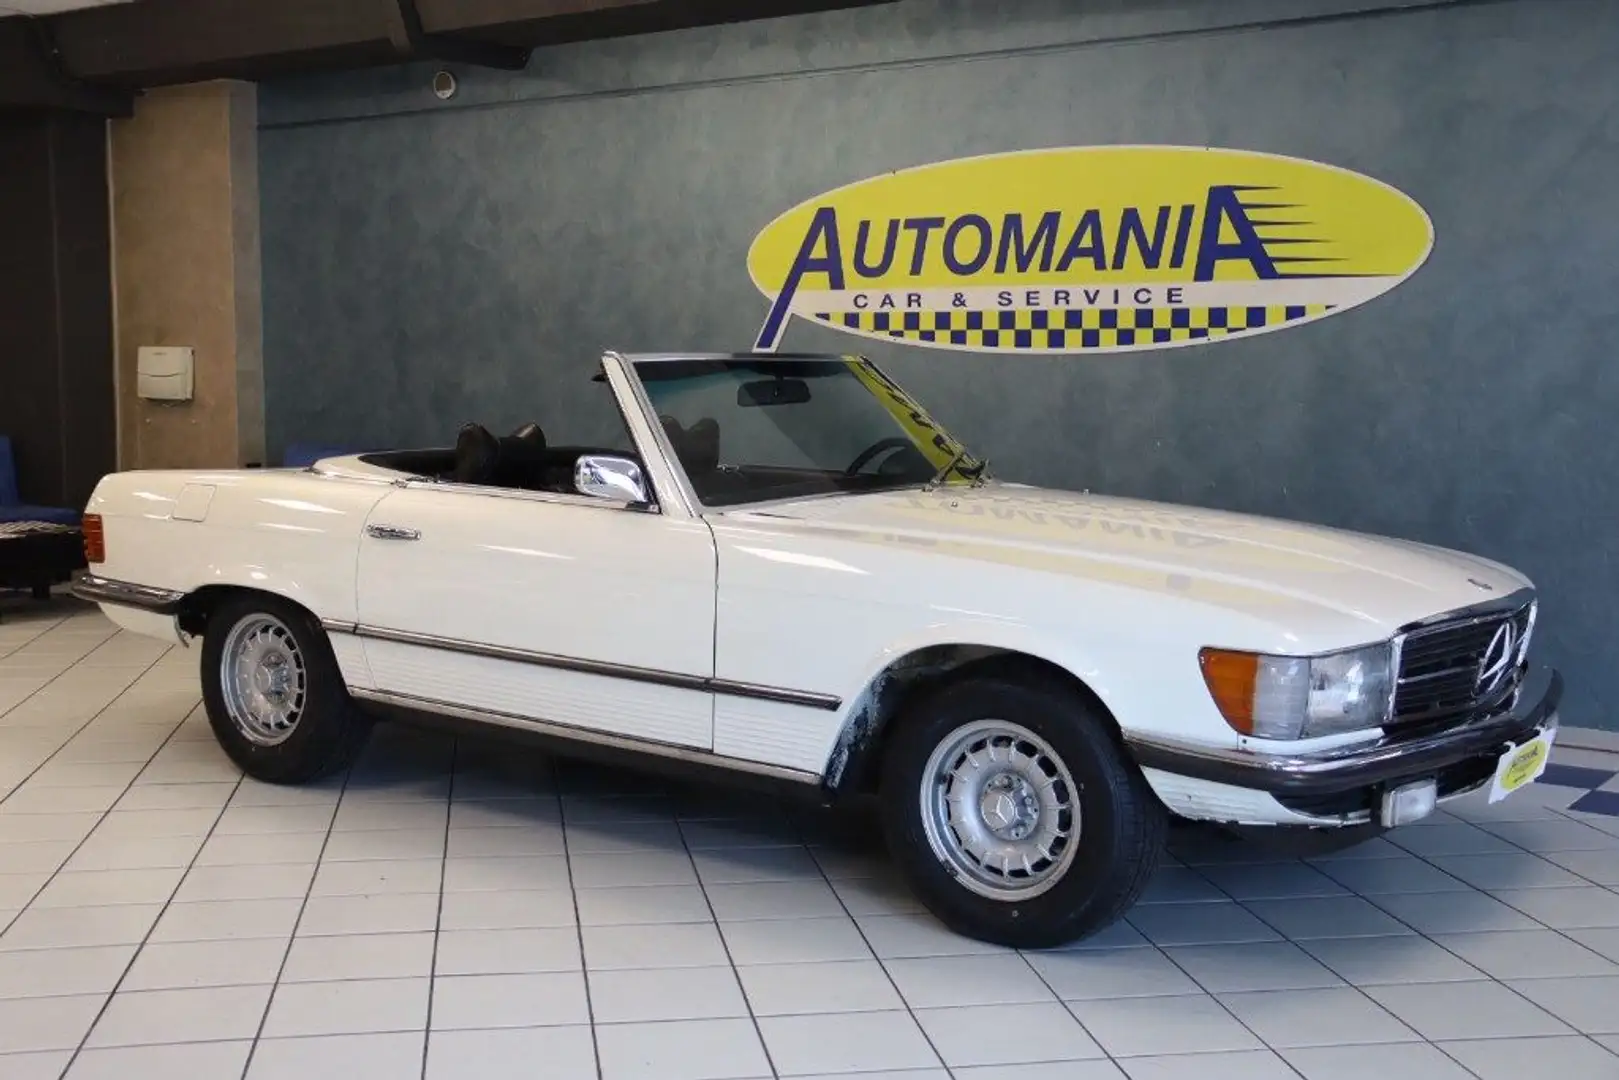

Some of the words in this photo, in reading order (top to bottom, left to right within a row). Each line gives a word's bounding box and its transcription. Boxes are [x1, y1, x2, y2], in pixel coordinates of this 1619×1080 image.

[755, 185, 1279, 348] AUTOMANIA
[853, 293, 922, 309] CAR
[951, 292, 967, 308] &
[997, 287, 1184, 306] SERVICE
